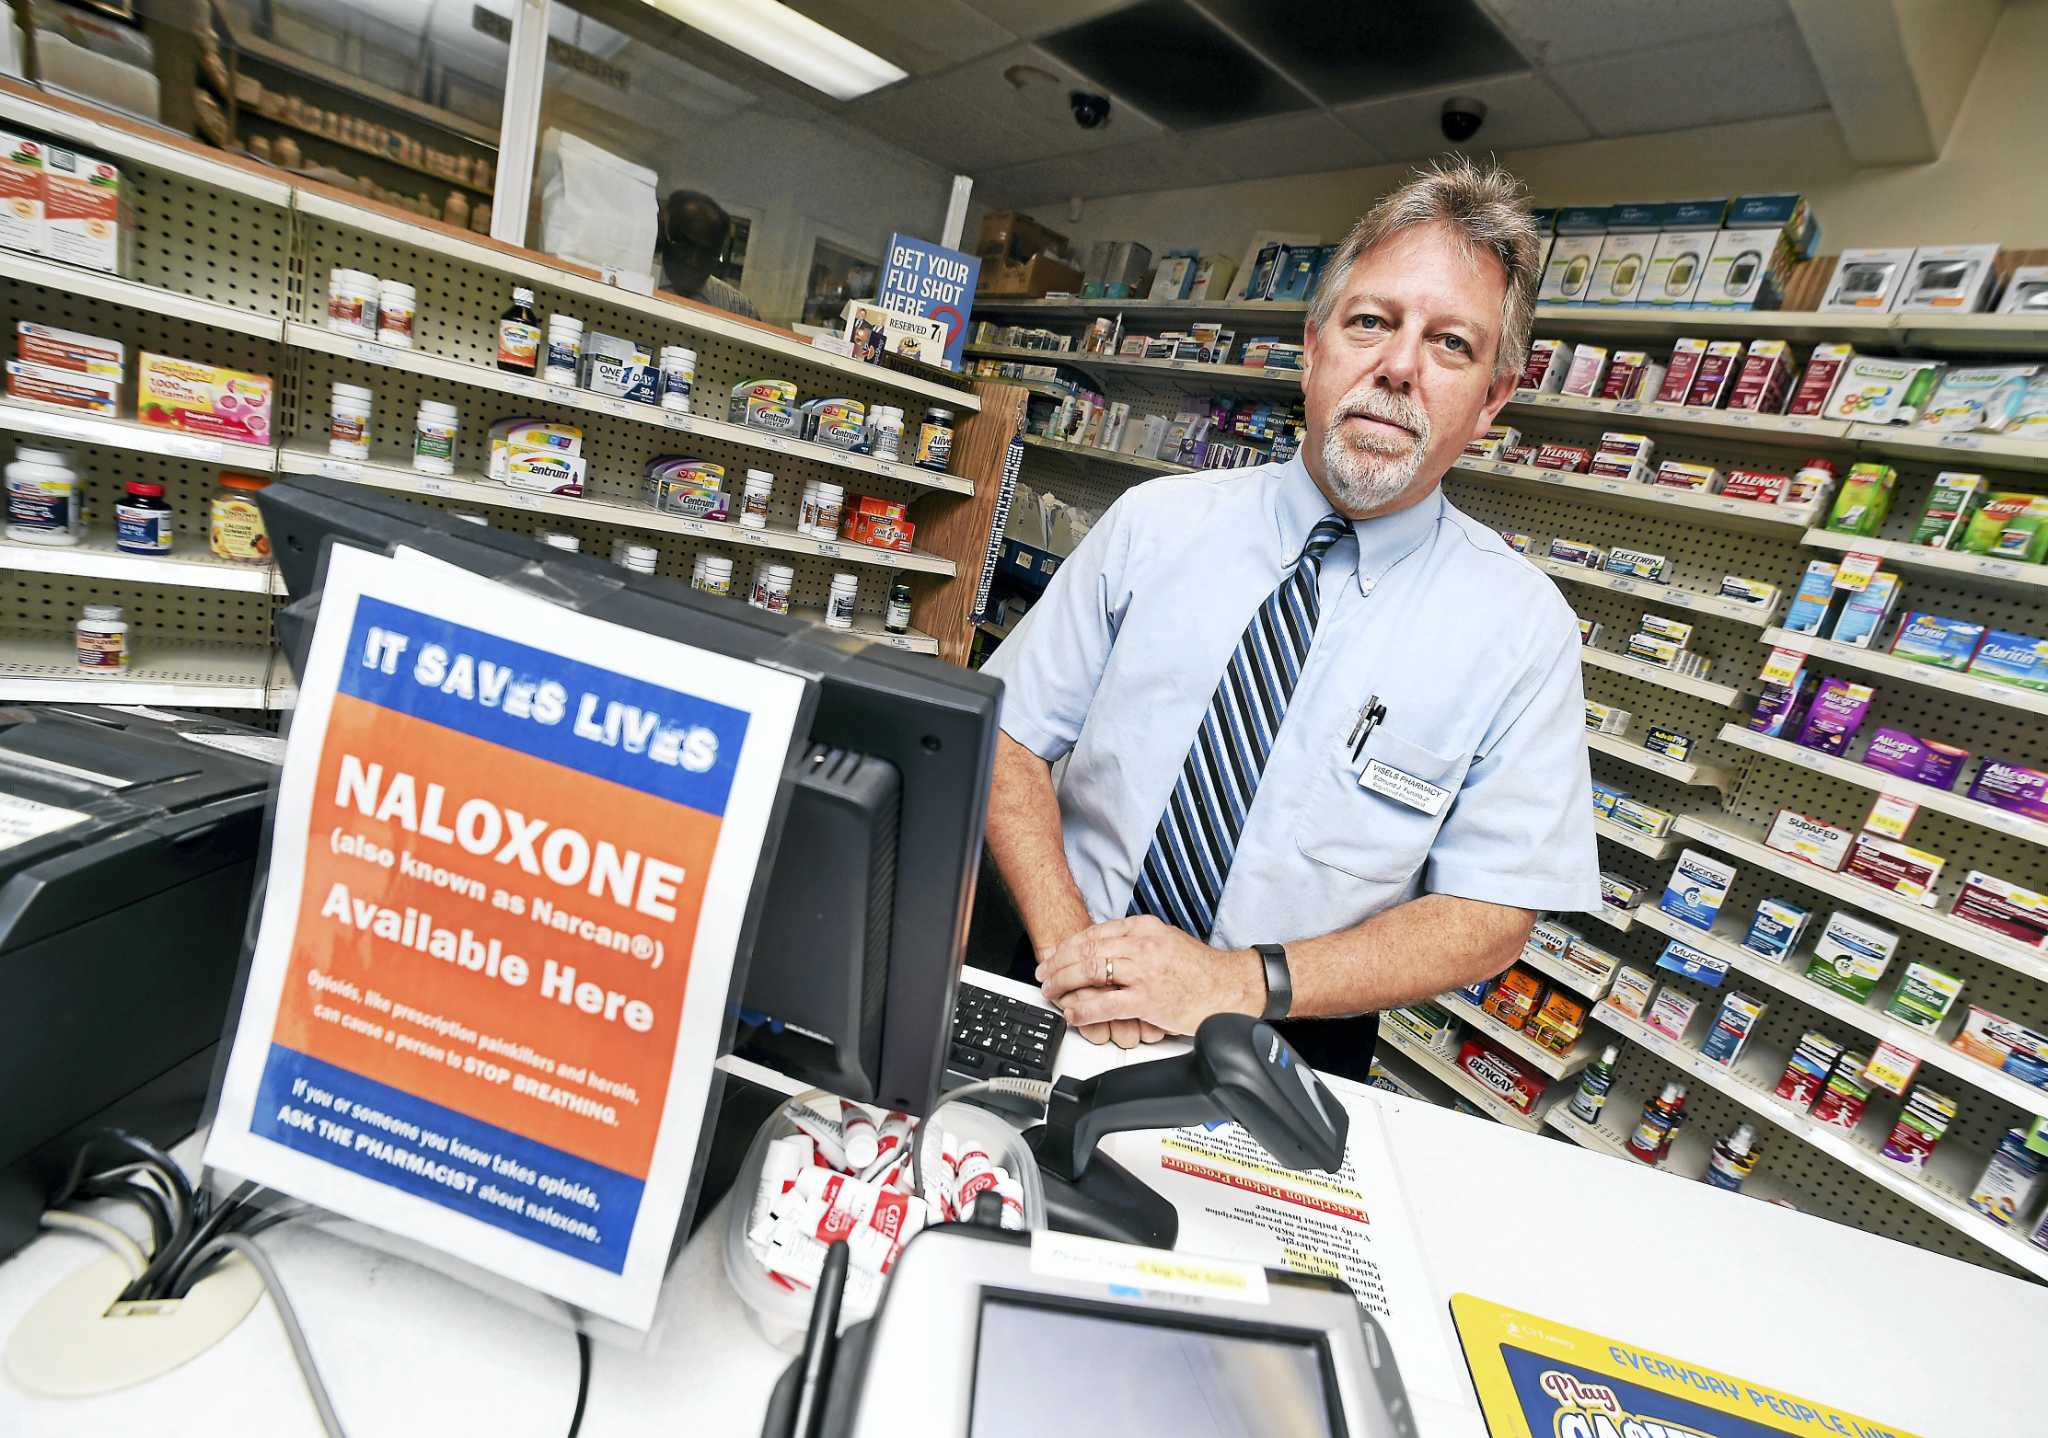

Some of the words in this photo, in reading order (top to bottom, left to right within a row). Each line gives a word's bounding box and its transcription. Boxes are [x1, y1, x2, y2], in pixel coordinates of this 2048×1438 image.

[892, 246, 925, 271] GET
[928, 254, 969, 284] YOUR
[887, 269, 918, 293] FLU
[920, 278, 964, 306] SHOT
[883, 292, 926, 317] HERE
[889, 318, 926, 335] RESERVED
[600, 366, 622, 377] ONE
[633, 374, 654, 386] DAY
[640, 388, 654, 396] 50+
[760, 410, 791, 425] Centrum
[831, 428, 860, 441] Centrum
[1541, 444, 1583, 464] TYLENOL
[529, 463, 569, 480] Centrum
[1727, 471, 1783, 488] TYLENOL
[683, 495, 714, 509] Centrum
[1611, 551, 1663, 567] EXCEDRIN
[1906, 624, 1947, 639] Claritin
[1981, 644, 2037, 665] Claritin
[361, 627, 407, 674] IT
[414, 642, 567, 726] SAVES
[574, 692, 719, 774] LIVES
[1870, 743, 1905, 760] Allergy
[1874, 735, 1920, 754] Allegra
[1986, 764, 2045, 787] Allegra
[1400, 775, 1442, 797] PHARMACY
[334, 755, 685, 923] NALOXONE
[1788, 816, 1839, 842] SUDAFED
[331, 827, 395, 869] (also
[400, 845, 486, 903] known
[493, 889, 524, 915] as
[1682, 860, 1728, 883] Mucinex
[1532, 926, 1563, 946] Ecotrin
[321, 883, 528, 986] Available
[540, 960, 654, 1033] Here
[1671, 945, 1726, 971] Mucinex
[308, 969, 362, 1004] Opioids,
[364, 986, 391, 1013] like
[393, 997, 478, 1044] prescription
[477, 1026, 555, 1074] painkillers
[557, 1059, 584, 1084] and
[586, 1067, 640, 1104] heroin,
[314, 1004, 338, 1023] can
[341, 1017, 382, 1041] cause
[396, 1034, 444, 1065] person
[447, 1049, 461, 1069] to
[463, 1056, 510, 1085] STOP
[513, 1073, 619, 1127] BREATHING.
[1469, 1057, 1514, 1092] BENGAY
[293, 1077, 306, 1097] If
[305, 1085, 332, 1106] you
[334, 1098, 349, 1115] or
[351, 1102, 419, 1142] someone
[419, 1129, 449, 1154] you
[449, 1136, 492, 1166] know
[493, 1154, 536, 1185] takes
[538, 1174, 601, 1212] opioids,
[277, 1105, 314, 1134] ASK
[318, 1118, 352, 1147] THE
[354, 1133, 478, 1195] PHARMACIST
[479, 1182, 525, 1213] about
[526, 1198, 602, 1243] naloxone.
[1161, 1155, 1232, 1183] Procedure
[1234, 1175, 1282, 1197] Pickup
[1294, 1175, 1328, 1189] patient
[1331, 1184, 1363, 1199] Verify
[1205, 1207, 1254, 1224] prescription
[1234, 1207, 1282, 1224] prescription
[1255, 1204, 1302, 1223] insurance
[1285, 1191, 1368, 1222] Prescription
[1304, 1217, 1338, 1232] patient
[1340, 1227, 1371, 1242] Verify
[1275, 1235, 1319, 1253] Allergies
[1283, 1248, 1307, 1261] Date
[1311, 1256, 1339, 1270] Birth
[1322, 1248, 1378, 1270] Medication
[1344, 1265, 1382, 1281] Patient
[1347, 1276, 1385, 1292] Patient
[1545, 1372, 1617, 1412] Play
[1608, 1346, 1740, 1401] EVERYDAY
[1748, 1387, 1855, 1437] PEOPLE
